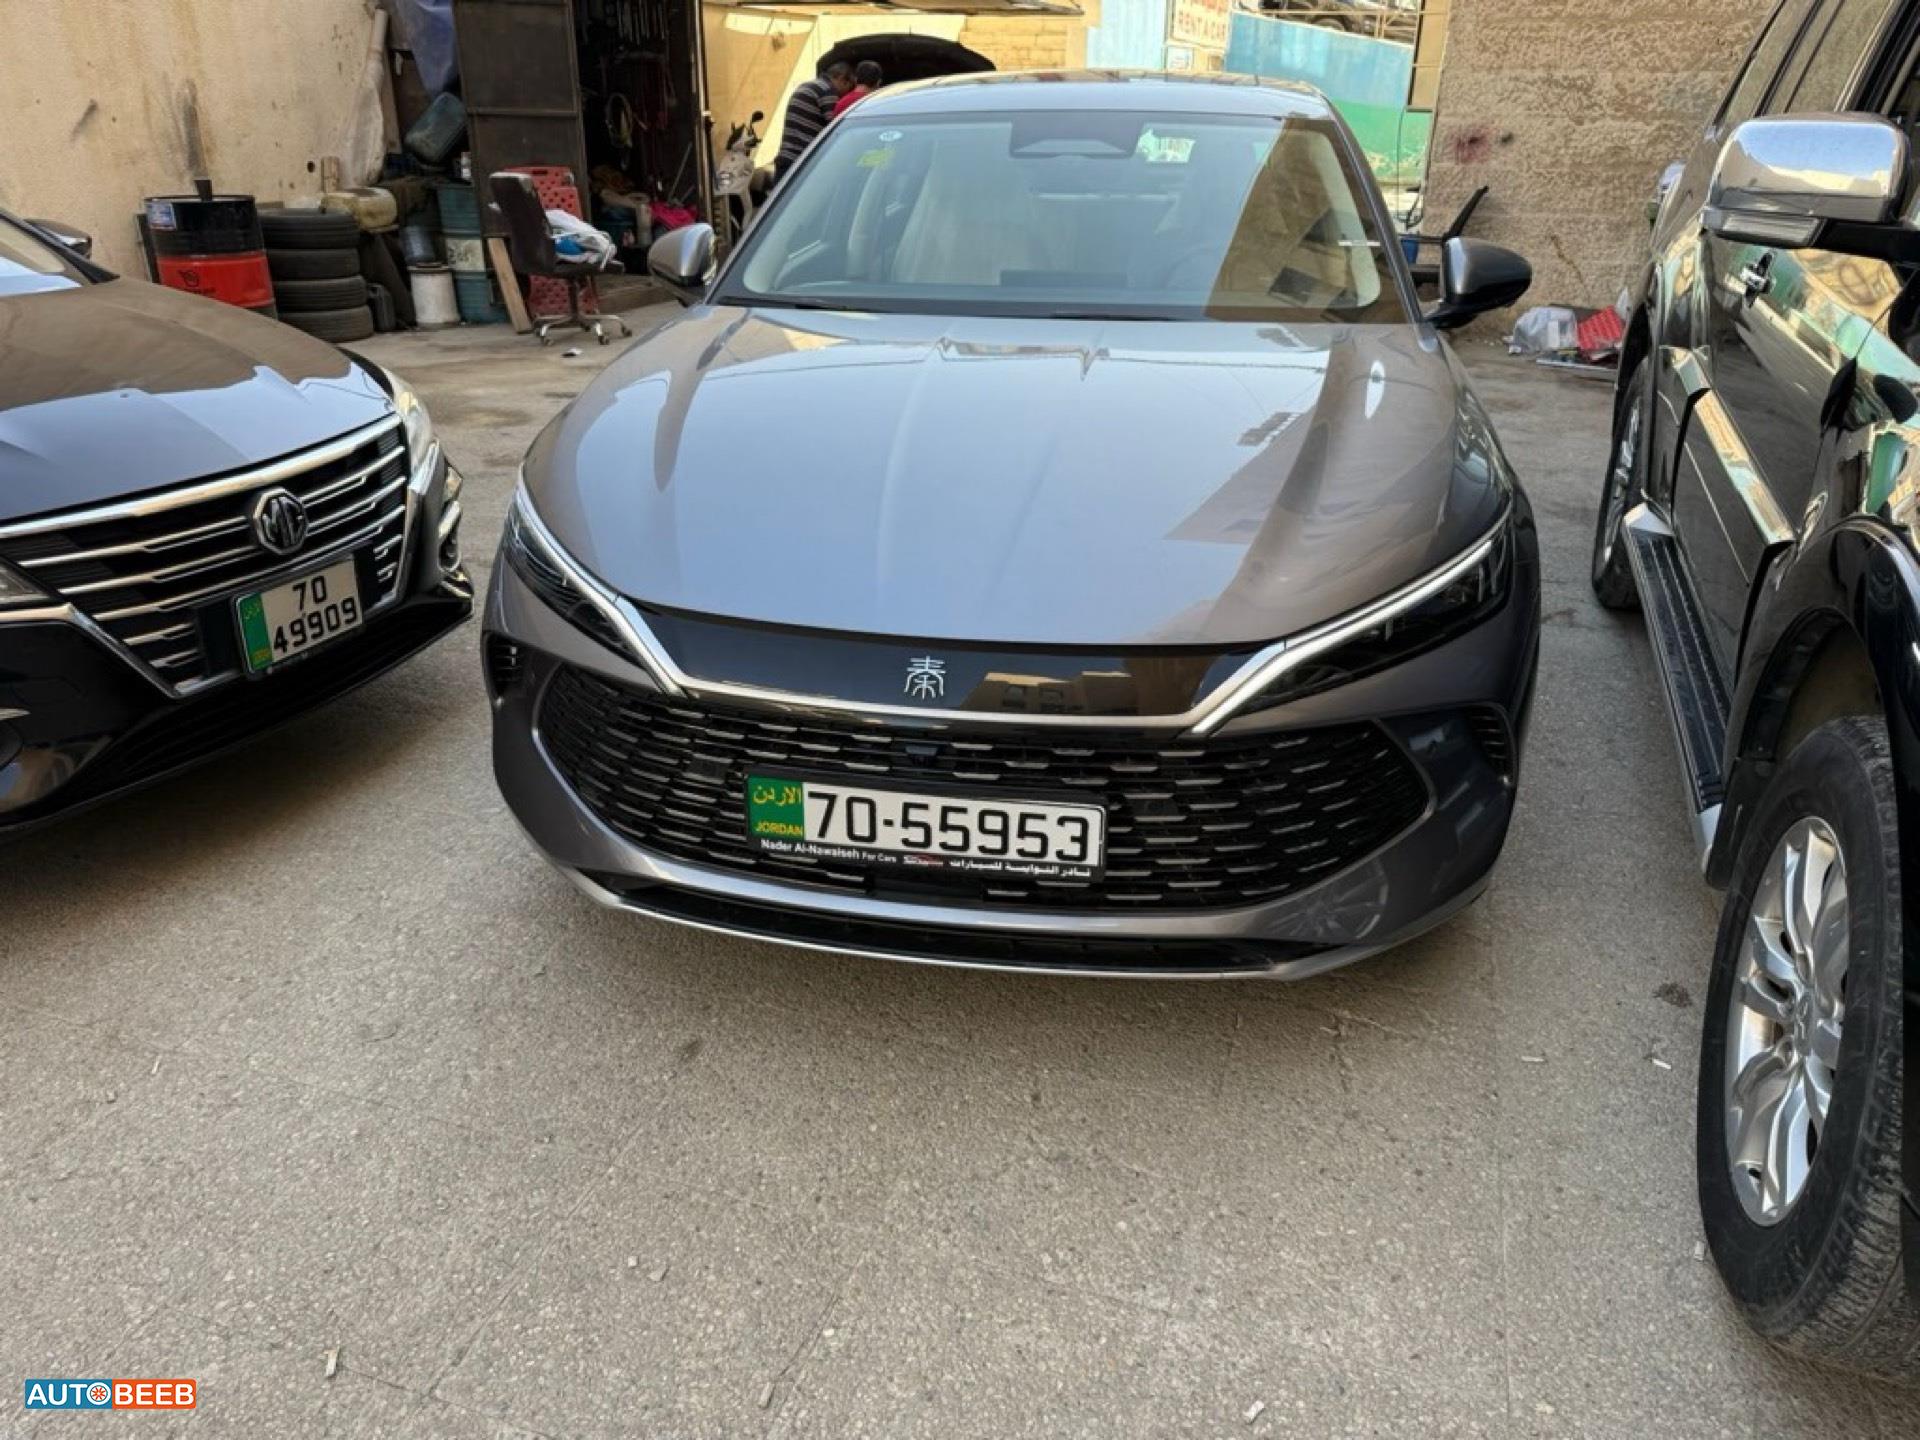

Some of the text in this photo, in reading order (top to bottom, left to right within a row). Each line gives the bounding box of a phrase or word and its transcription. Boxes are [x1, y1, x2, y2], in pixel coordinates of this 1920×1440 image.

[262, 495, 304, 547] MG
[292, 576, 327, 611] 70
[274, 597, 358, 653] 49909
[756, 821, 803, 836] JORDAN
[761, 839, 792, 850] Nader
[808, 791, 1088, 862] 70-55953
